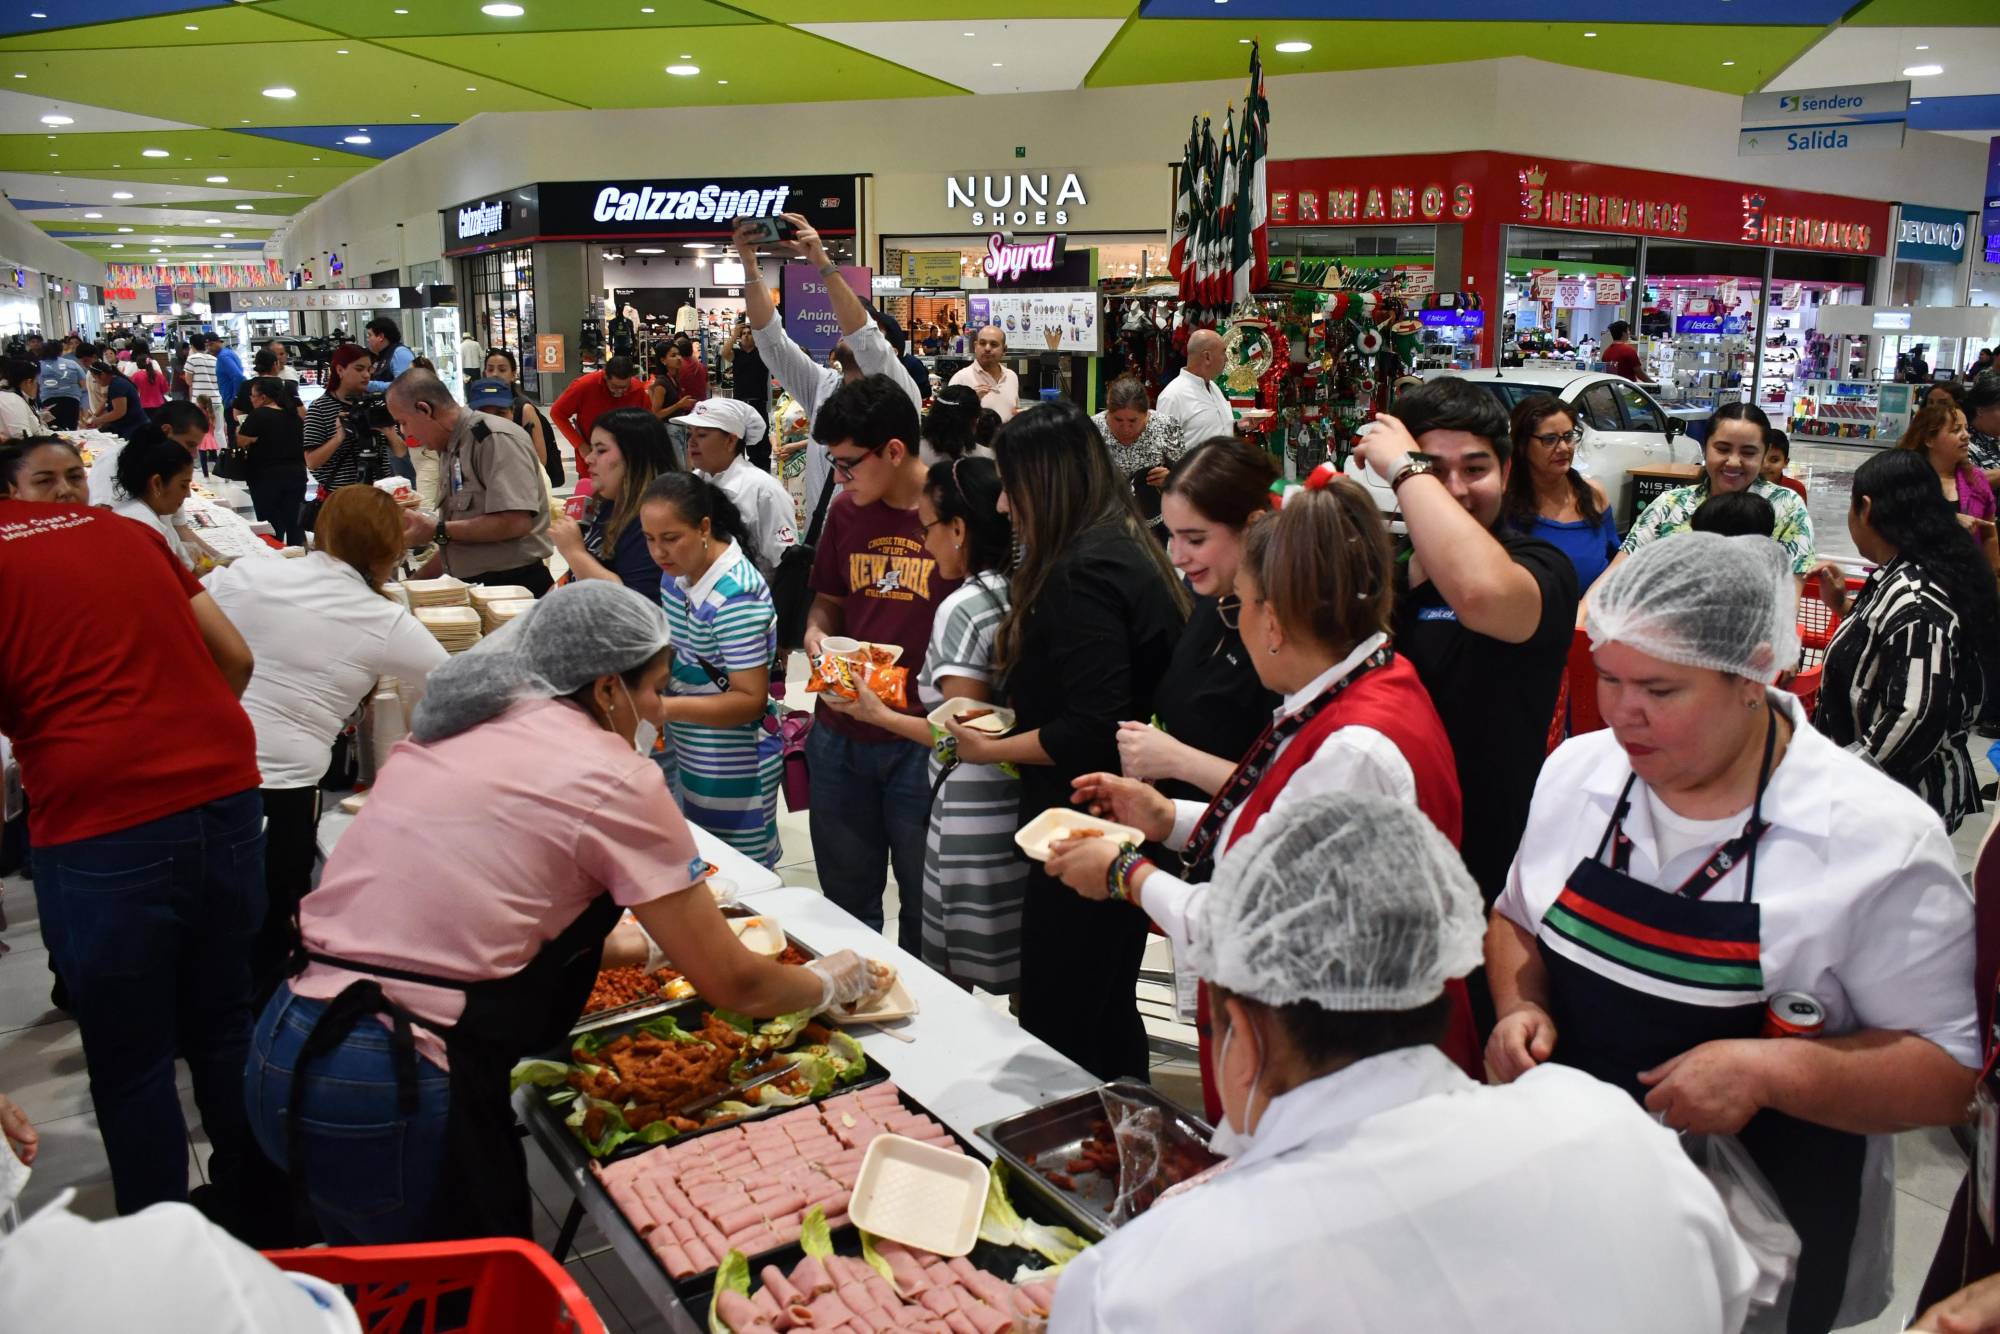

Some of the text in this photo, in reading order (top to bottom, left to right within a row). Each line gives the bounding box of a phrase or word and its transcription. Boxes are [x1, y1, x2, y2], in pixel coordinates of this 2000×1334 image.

[1802, 95, 1863, 111] sendero
[1787, 130, 1849, 151] Salida
[947, 173, 1087, 208] NUNA
[1271, 184, 1474, 221] ERMANOS
[593, 185, 790, 222] CalzzaSport
[1551, 191, 1689, 233] HERMANOS
[458, 200, 503, 239] CalzzaSport
[972, 211, 1068, 226] SHOES
[1765, 215, 1871, 250] HERMANOS
[983, 232, 1057, 281] Spyral
[797, 308, 838, 321] Anúnc
[545, 346, 557, 364] 8
[1639, 481, 1688, 491] NISSA
[1, 516, 95, 541] Mejores Precios
[891, 547, 904, 556] LIFE
[893, 537, 906, 546] THE
[906, 539, 922, 553] BEST
[849, 553, 937, 601] NEW YORK
